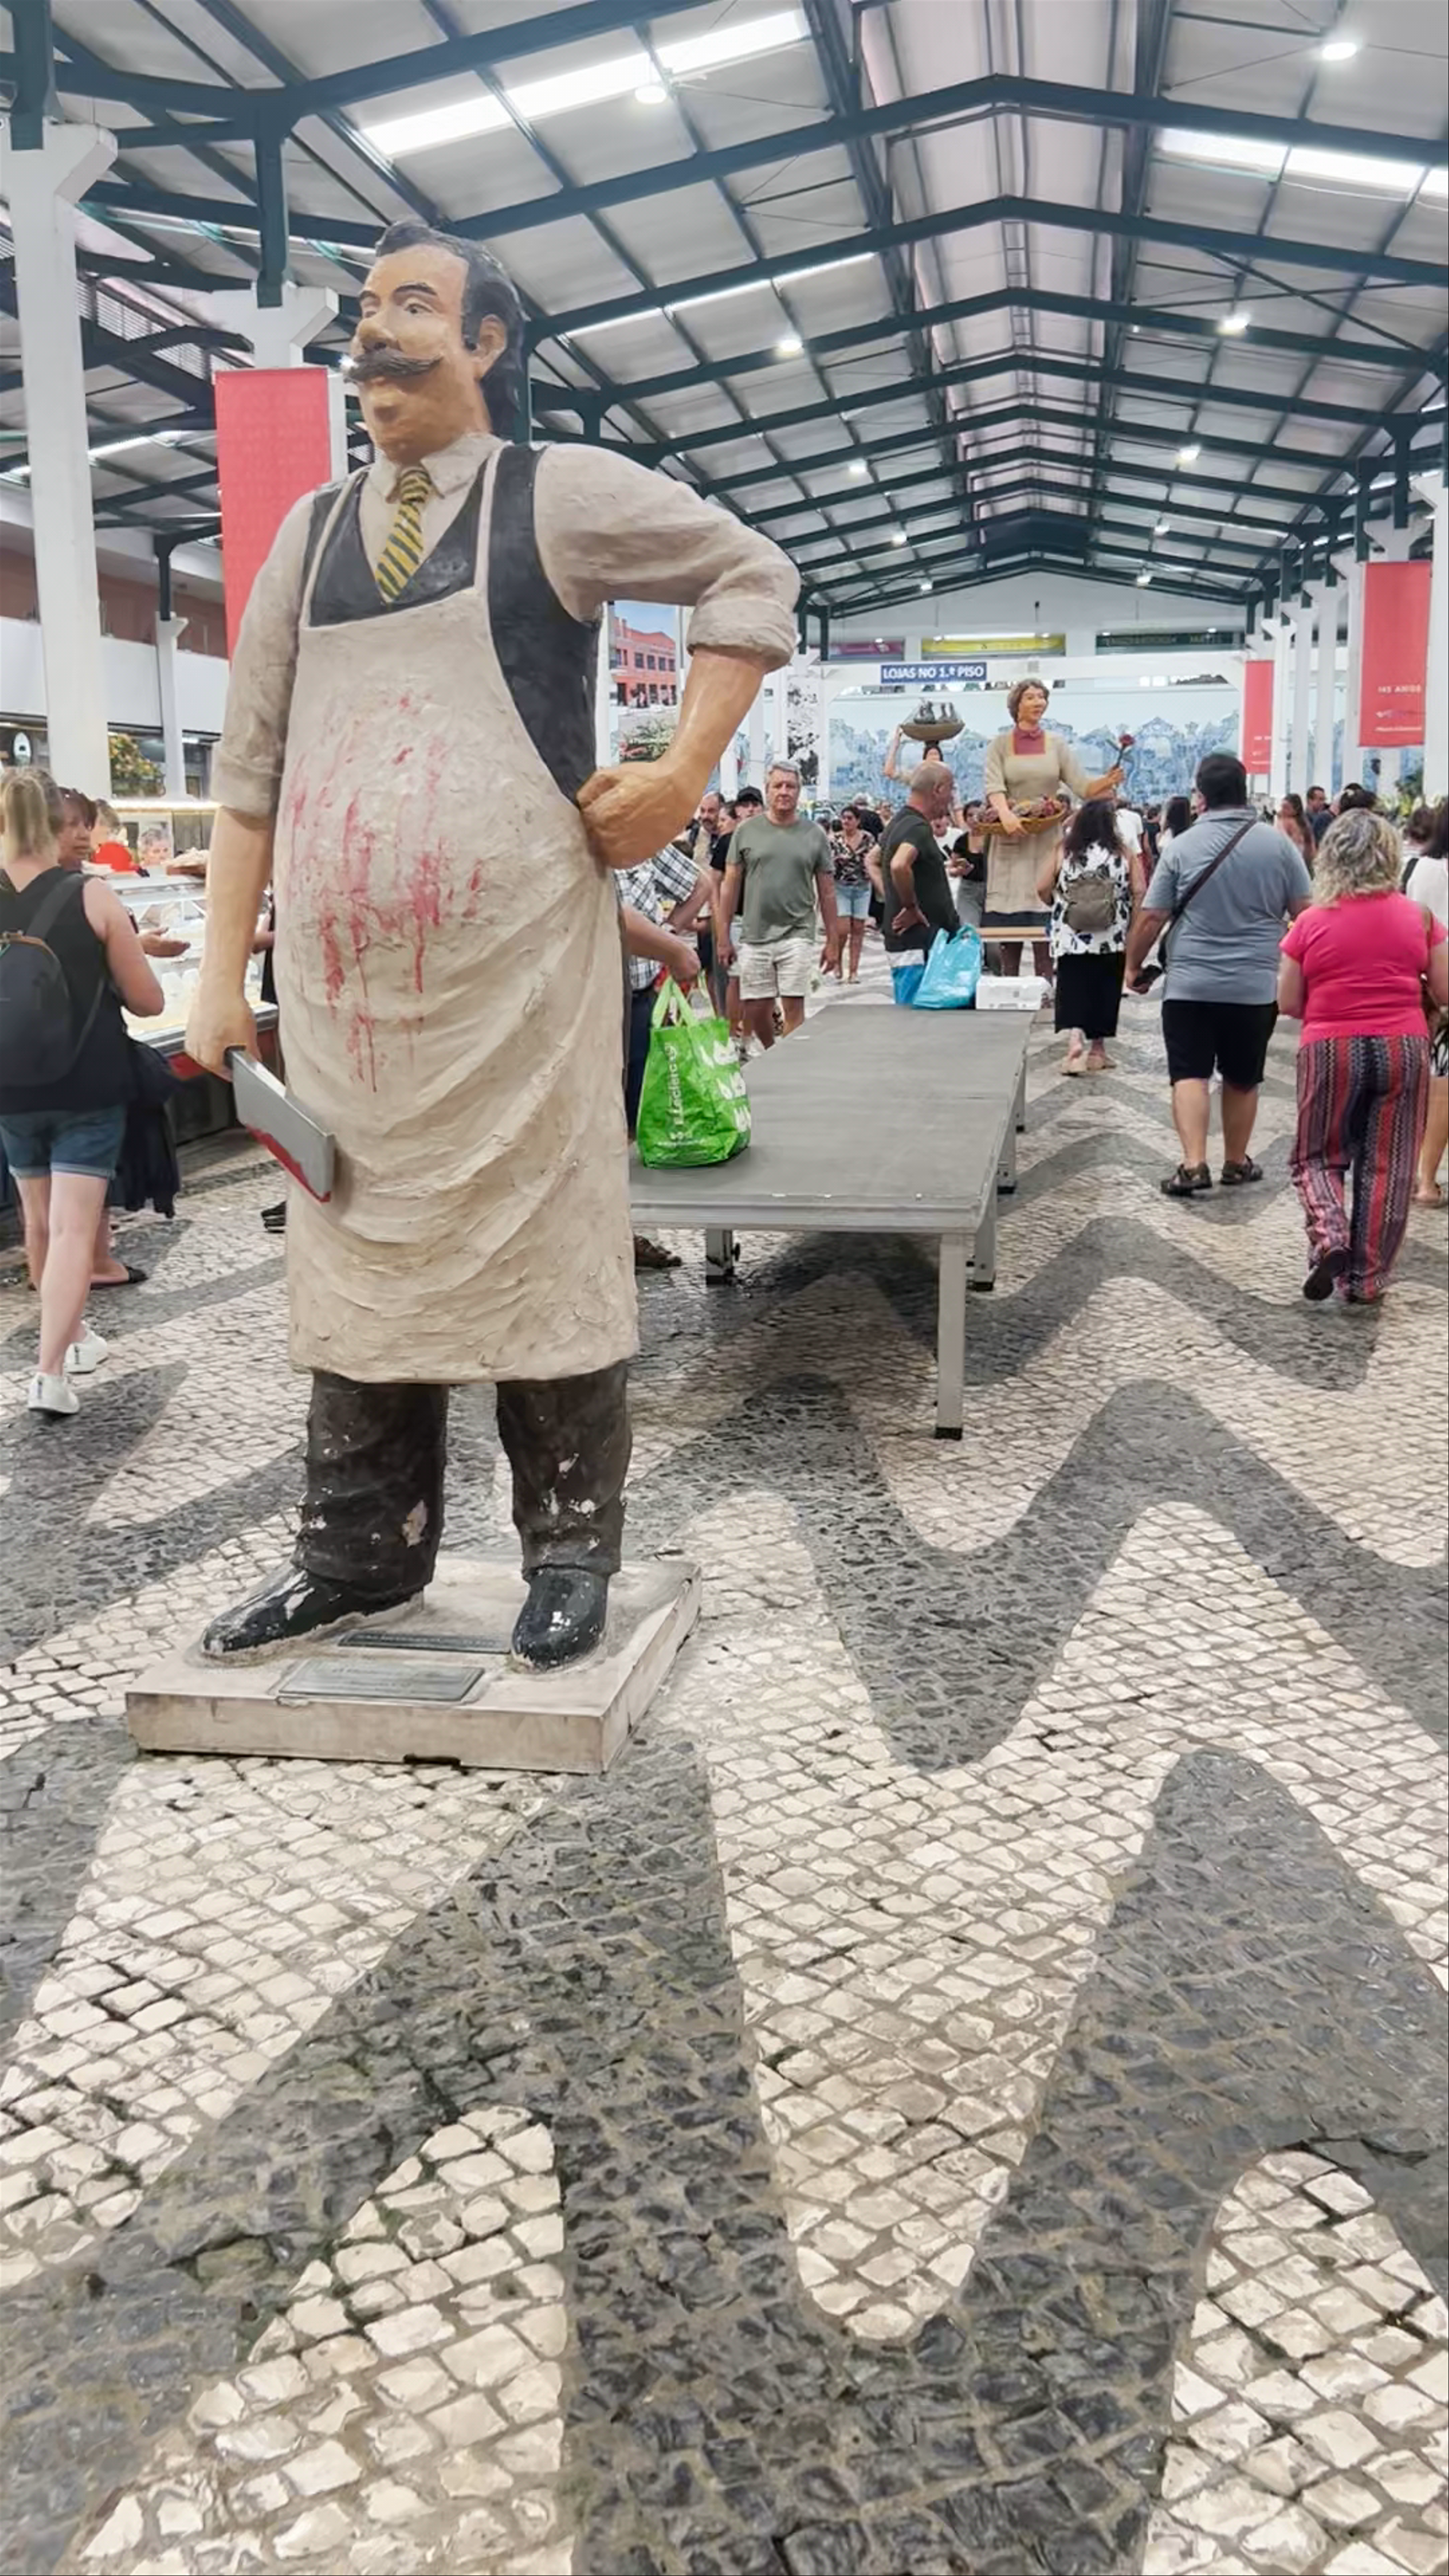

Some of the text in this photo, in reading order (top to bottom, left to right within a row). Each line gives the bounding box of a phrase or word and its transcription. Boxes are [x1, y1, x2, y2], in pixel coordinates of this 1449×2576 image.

[883, 667, 915, 679] LOJAS
[918, 667, 936, 678] NO
[958, 665, 984, 677] PISO
